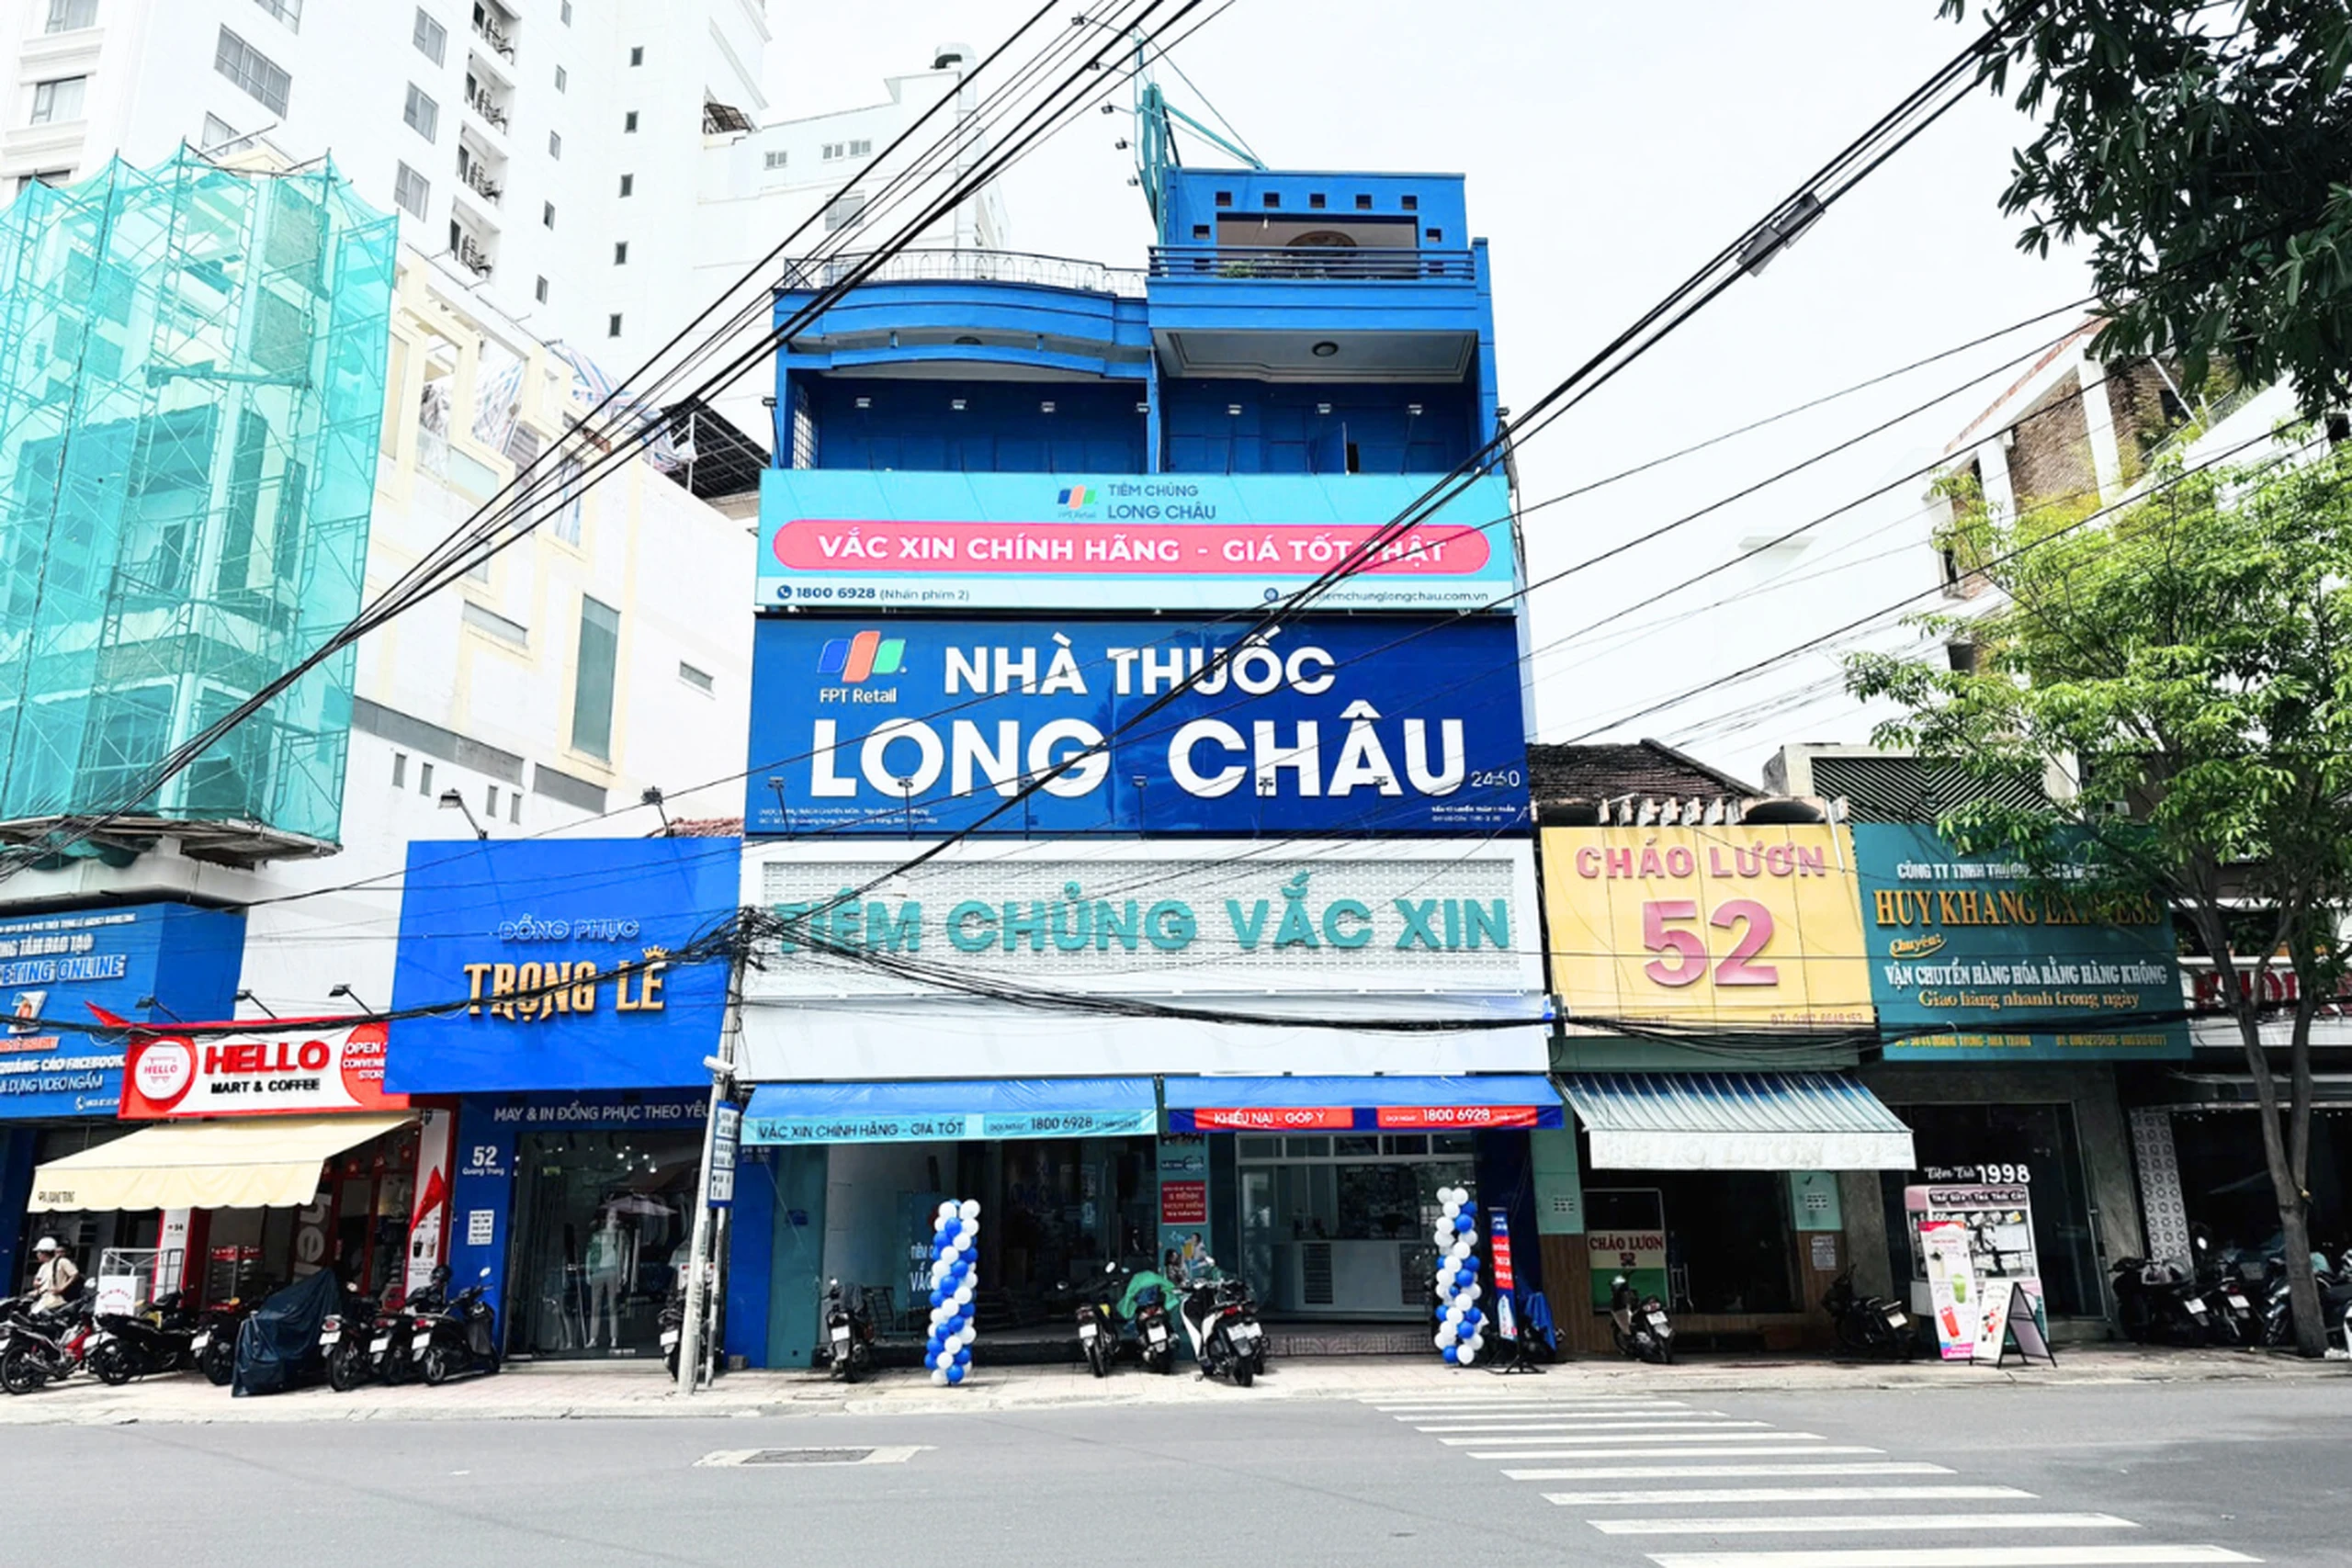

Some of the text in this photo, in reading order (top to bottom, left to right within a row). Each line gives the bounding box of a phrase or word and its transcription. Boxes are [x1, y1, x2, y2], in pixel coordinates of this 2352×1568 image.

[1107, 481, 1199, 497] TIÊM CHỦNG
[1107, 502, 1216, 520] LONG CHÂU
[818, 526, 890, 558] VẮC
[899, 537, 956, 559] XIN
[967, 533, 1074, 561] CHÍNH
[1085, 535, 1181, 561] HÃNG
[1223, 535, 1280, 561] GIÁ
[1288, 532, 1352, 561] TỐT
[796, 587, 832, 599] 1800
[838, 587, 876, 599] 6928
[956, 589, 970, 601] 2)
[944, 626, 1336, 696] NHÀ THUỐC
[820, 688, 897, 704] FPT Retail
[810, 700, 1466, 798] LONG CHÂU
[1575, 838, 1826, 878] CHÁO LƯƠN
[1897, 860, 1932, 879] CÔNG
[1933, 863, 1950, 878] TY
[945, 881, 1197, 953] CHỦNG
[1225, 871, 1374, 951] VẮC
[1393, 897, 1510, 950] XIN
[1873, 889, 1933, 925] HUY
[1939, 889, 2037, 925] KHANG
[498, 913, 640, 942] ĐỒNG PHỤC
[1642, 897, 1779, 987] 52
[57, 954, 127, 981] ONLINE
[1884, 955, 2168, 991] VẬN CHUYỂN HÀNG HÓA BẰNG HÀNG KHÔNG
[464, 961, 597, 1022] TRỌNG
[1918, 989, 2140, 1010] Giao hàng nhanh trong ngày
[205, 1041, 330, 1075] HELLO
[345, 1042, 381, 1055] OPEN
[144, 1065, 178, 1075] HELLO
[210, 1077, 321, 1094] MART & COFFEE
[494, 1108, 523, 1122] MAY
[526, 1107, 537, 1121] &
[539, 1106, 555, 1120] IN
[557, 1100, 598, 1120] ĐỒNG
[603, 1105, 641, 1122] PHỤC
[645, 1104, 681, 1119] THEO
[1423, 1108, 1453, 1122] 1800
[1456, 1108, 1490, 1122] 6928
[791, 1126, 813, 1138] XIN
[816, 1122, 856, 1137] CHÍNH
[910, 1121, 933, 1135] GIÁ
[1031, 1118, 1059, 1130] 1800
[1062, 1117, 1092, 1129] 6928
[472, 1145, 498, 1167] 52
[1976, 1164, 2031, 1184] 1998
[1589, 1233, 1624, 1251] CHÁO
[1620, 1252, 1636, 1268] 52
